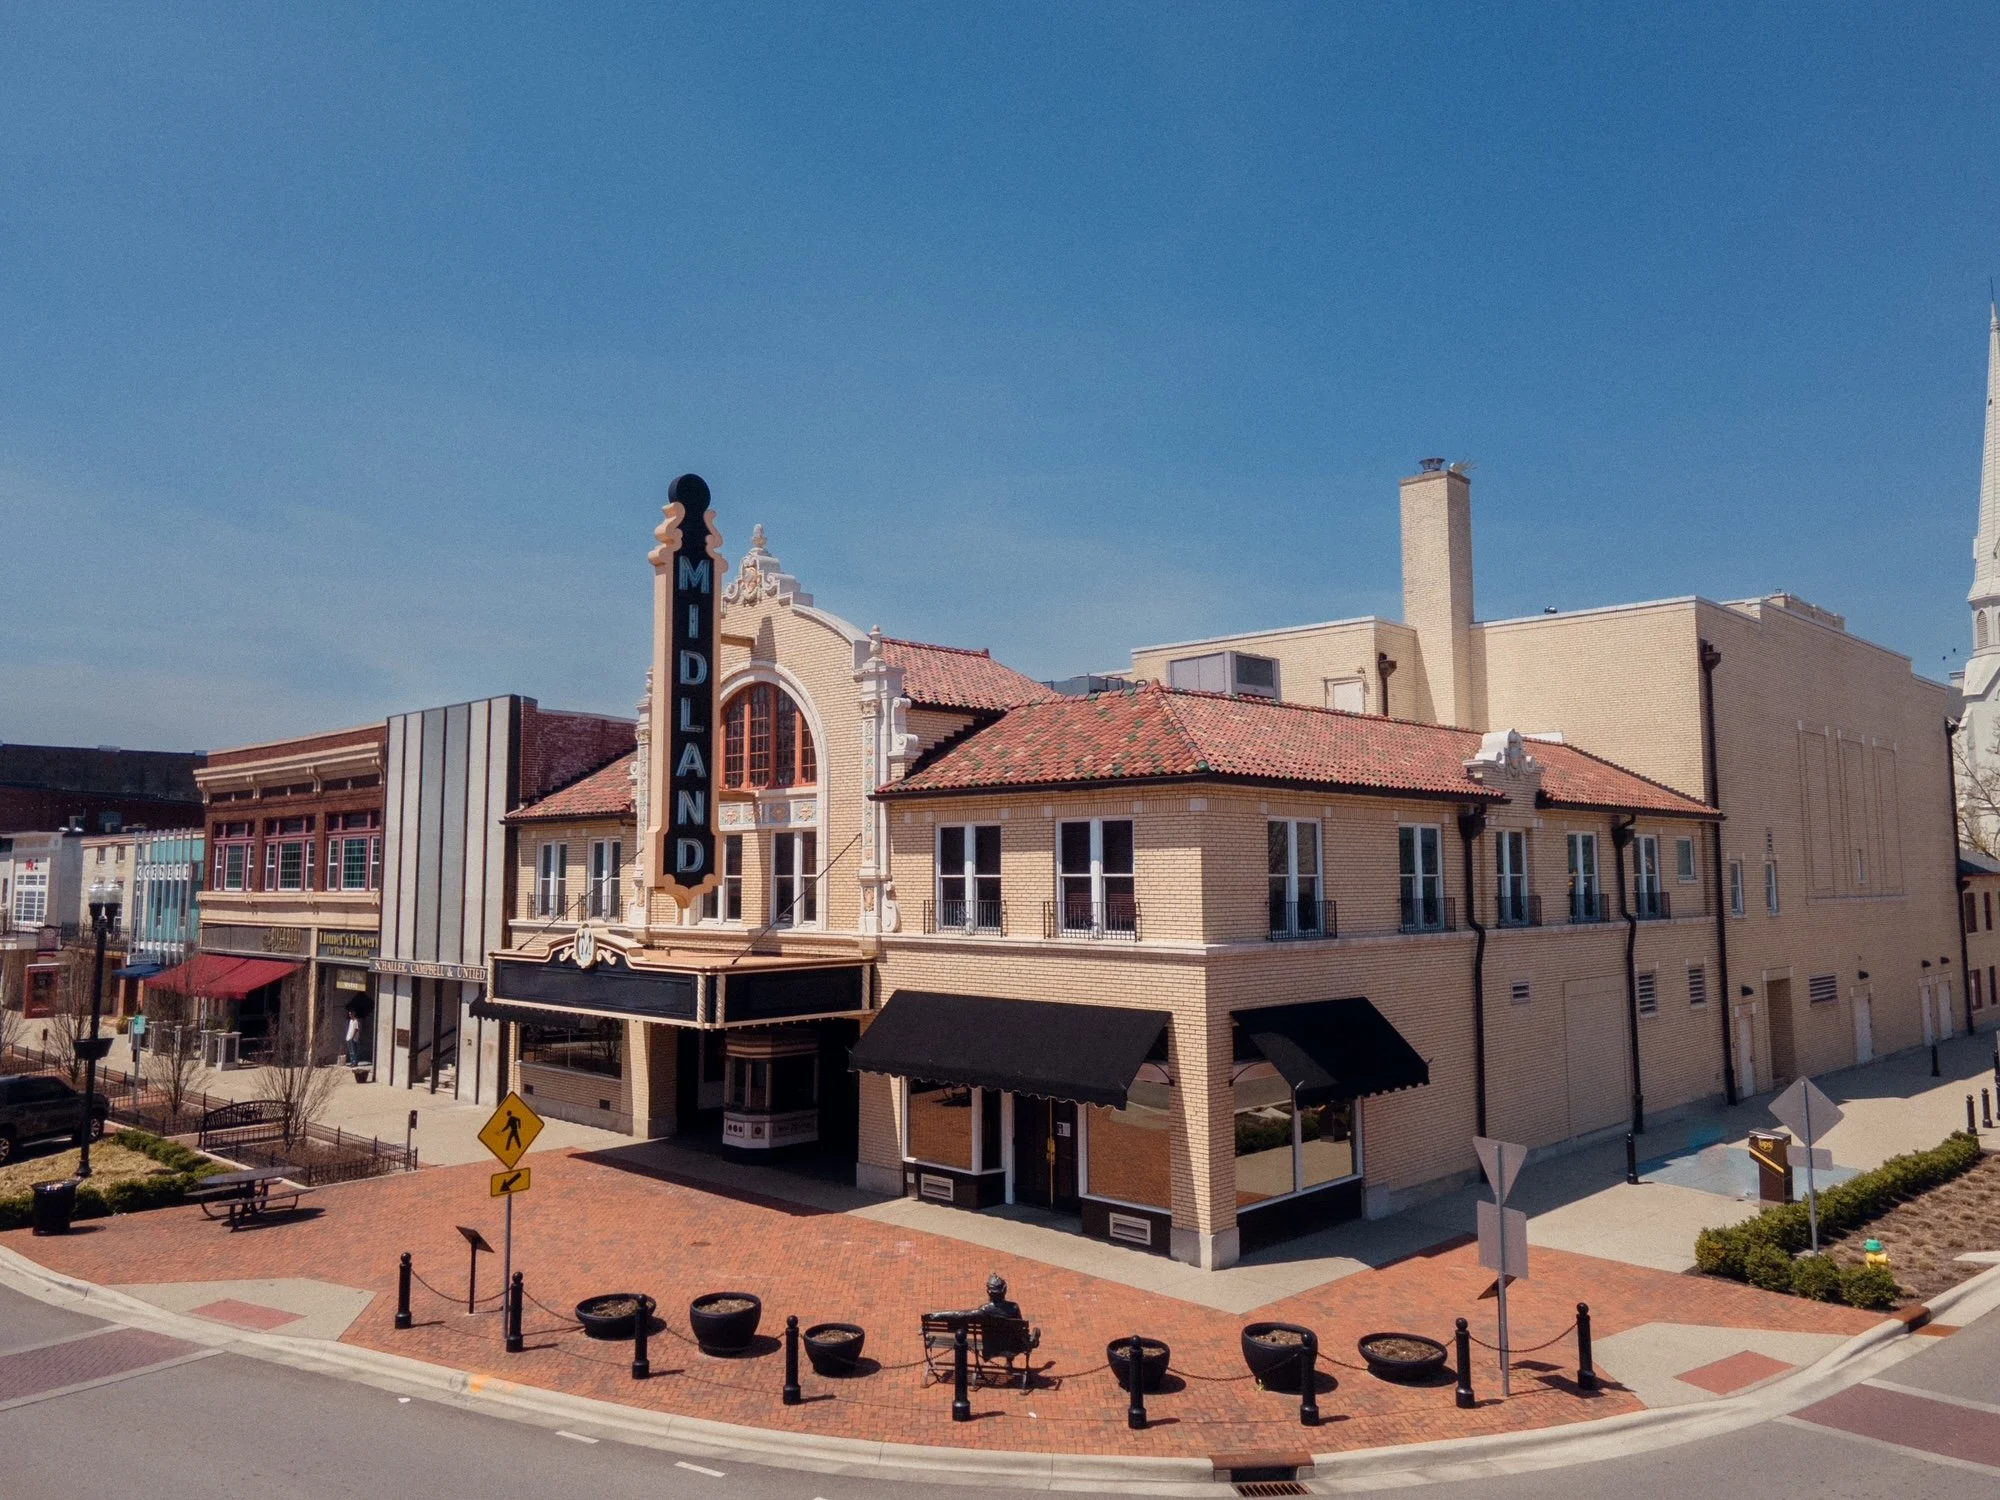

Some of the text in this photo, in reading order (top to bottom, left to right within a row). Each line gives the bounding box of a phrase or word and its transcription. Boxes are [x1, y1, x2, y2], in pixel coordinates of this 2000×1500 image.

[677, 555, 711, 874] MIDLAND
[410, 961, 444, 977] CAMPBELL
[447, 967, 453, 977] &
[457, 967, 485, 980] UNTIED
